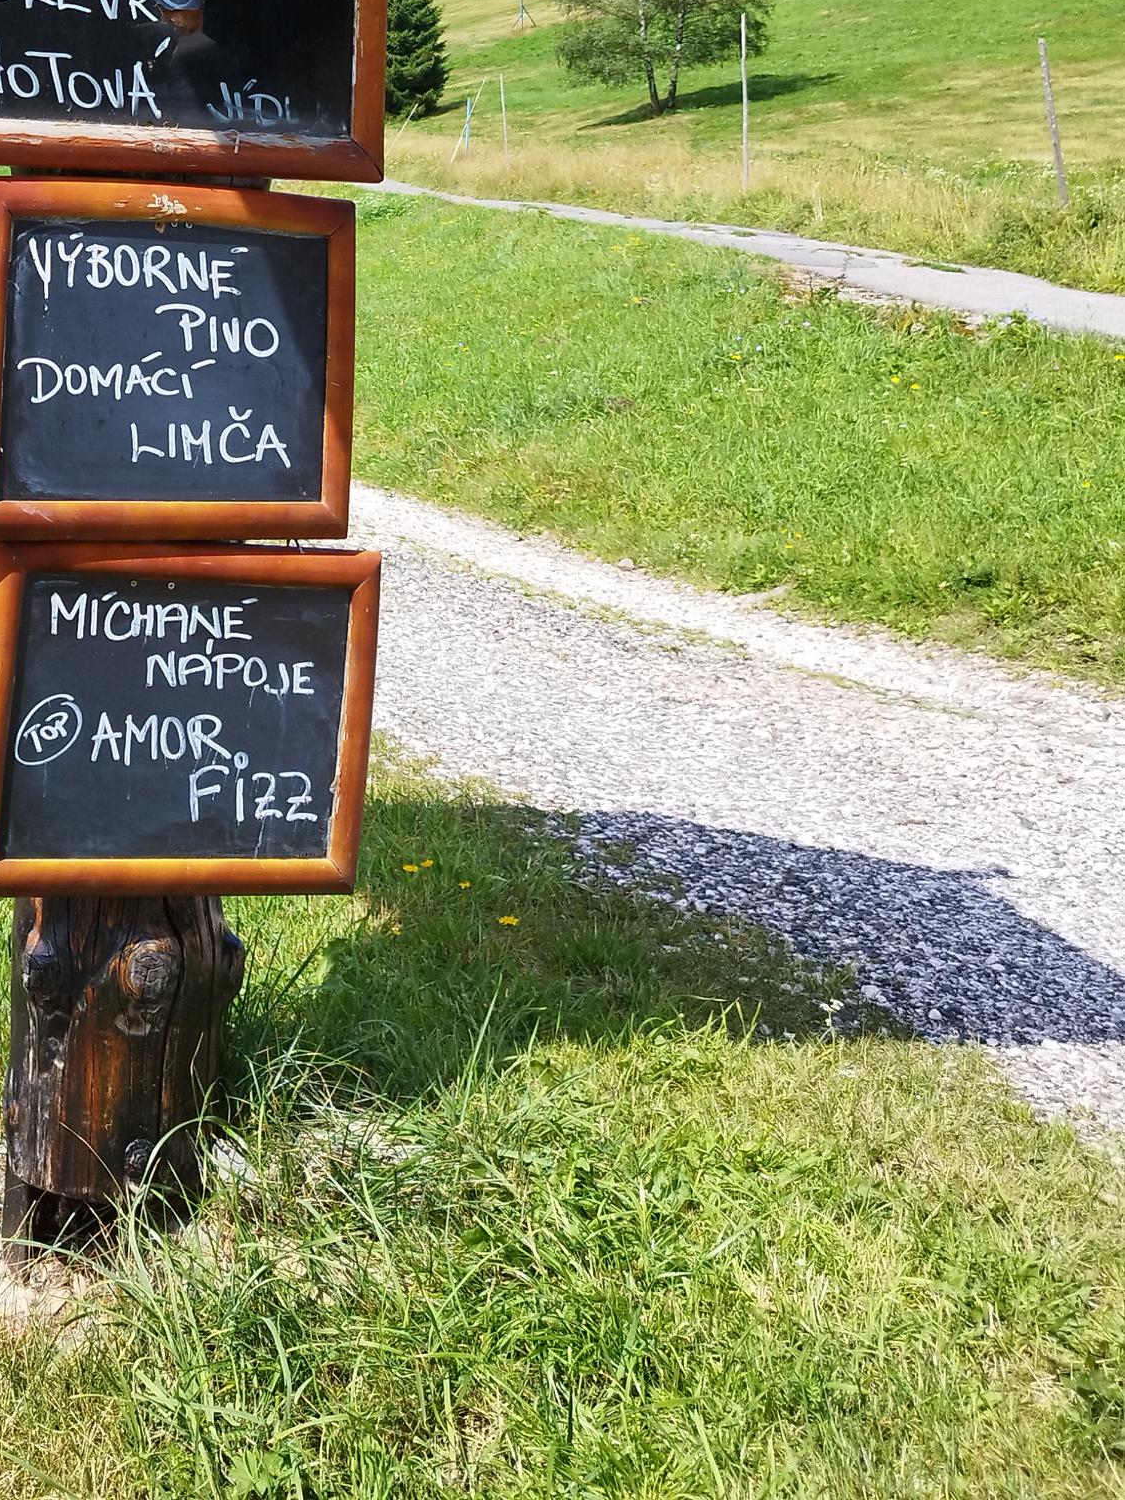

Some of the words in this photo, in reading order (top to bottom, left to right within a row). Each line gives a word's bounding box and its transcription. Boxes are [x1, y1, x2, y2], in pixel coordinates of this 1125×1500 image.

[28, 232, 250, 300] VÝBORNÉ
[154, 303, 280, 358] PIVO
[17, 351, 216, 404] DOMÁCÍ
[130, 405, 292, 469] LIMČA
[49, 590, 259, 644] MÍCHANÉ
[144, 638, 316, 696] NÁPOJE
[22, 710, 69, 754] TOP
[90, 710, 233, 767] AMOR
